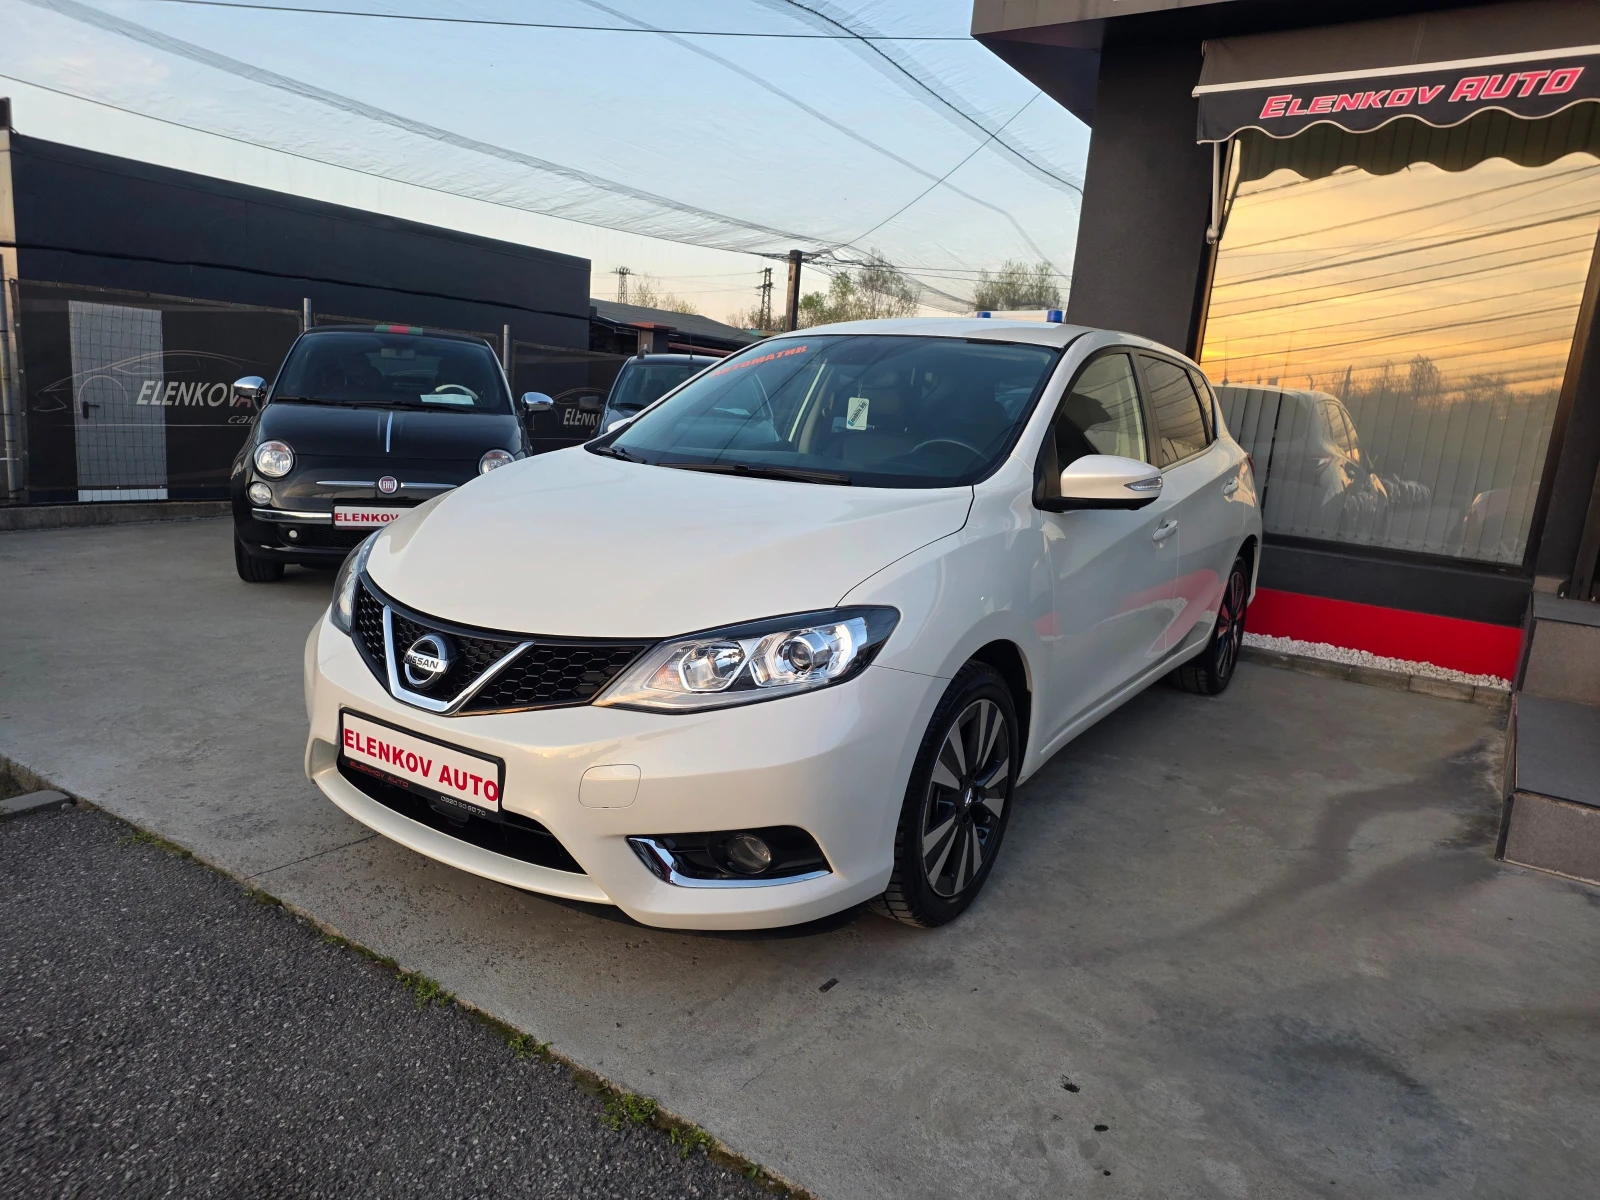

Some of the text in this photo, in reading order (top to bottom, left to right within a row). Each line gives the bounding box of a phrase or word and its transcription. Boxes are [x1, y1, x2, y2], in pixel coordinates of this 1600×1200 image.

[1259, 67, 1585, 119] ELENKOV AUTO
[563, 408, 601, 426] ELENK
[382, 480, 394, 489] FIAT
[404, 654, 439, 669] NISSAN
[344, 728, 499, 801] ELENKOV AUTO
[387, 775, 409, 788] AUTO
